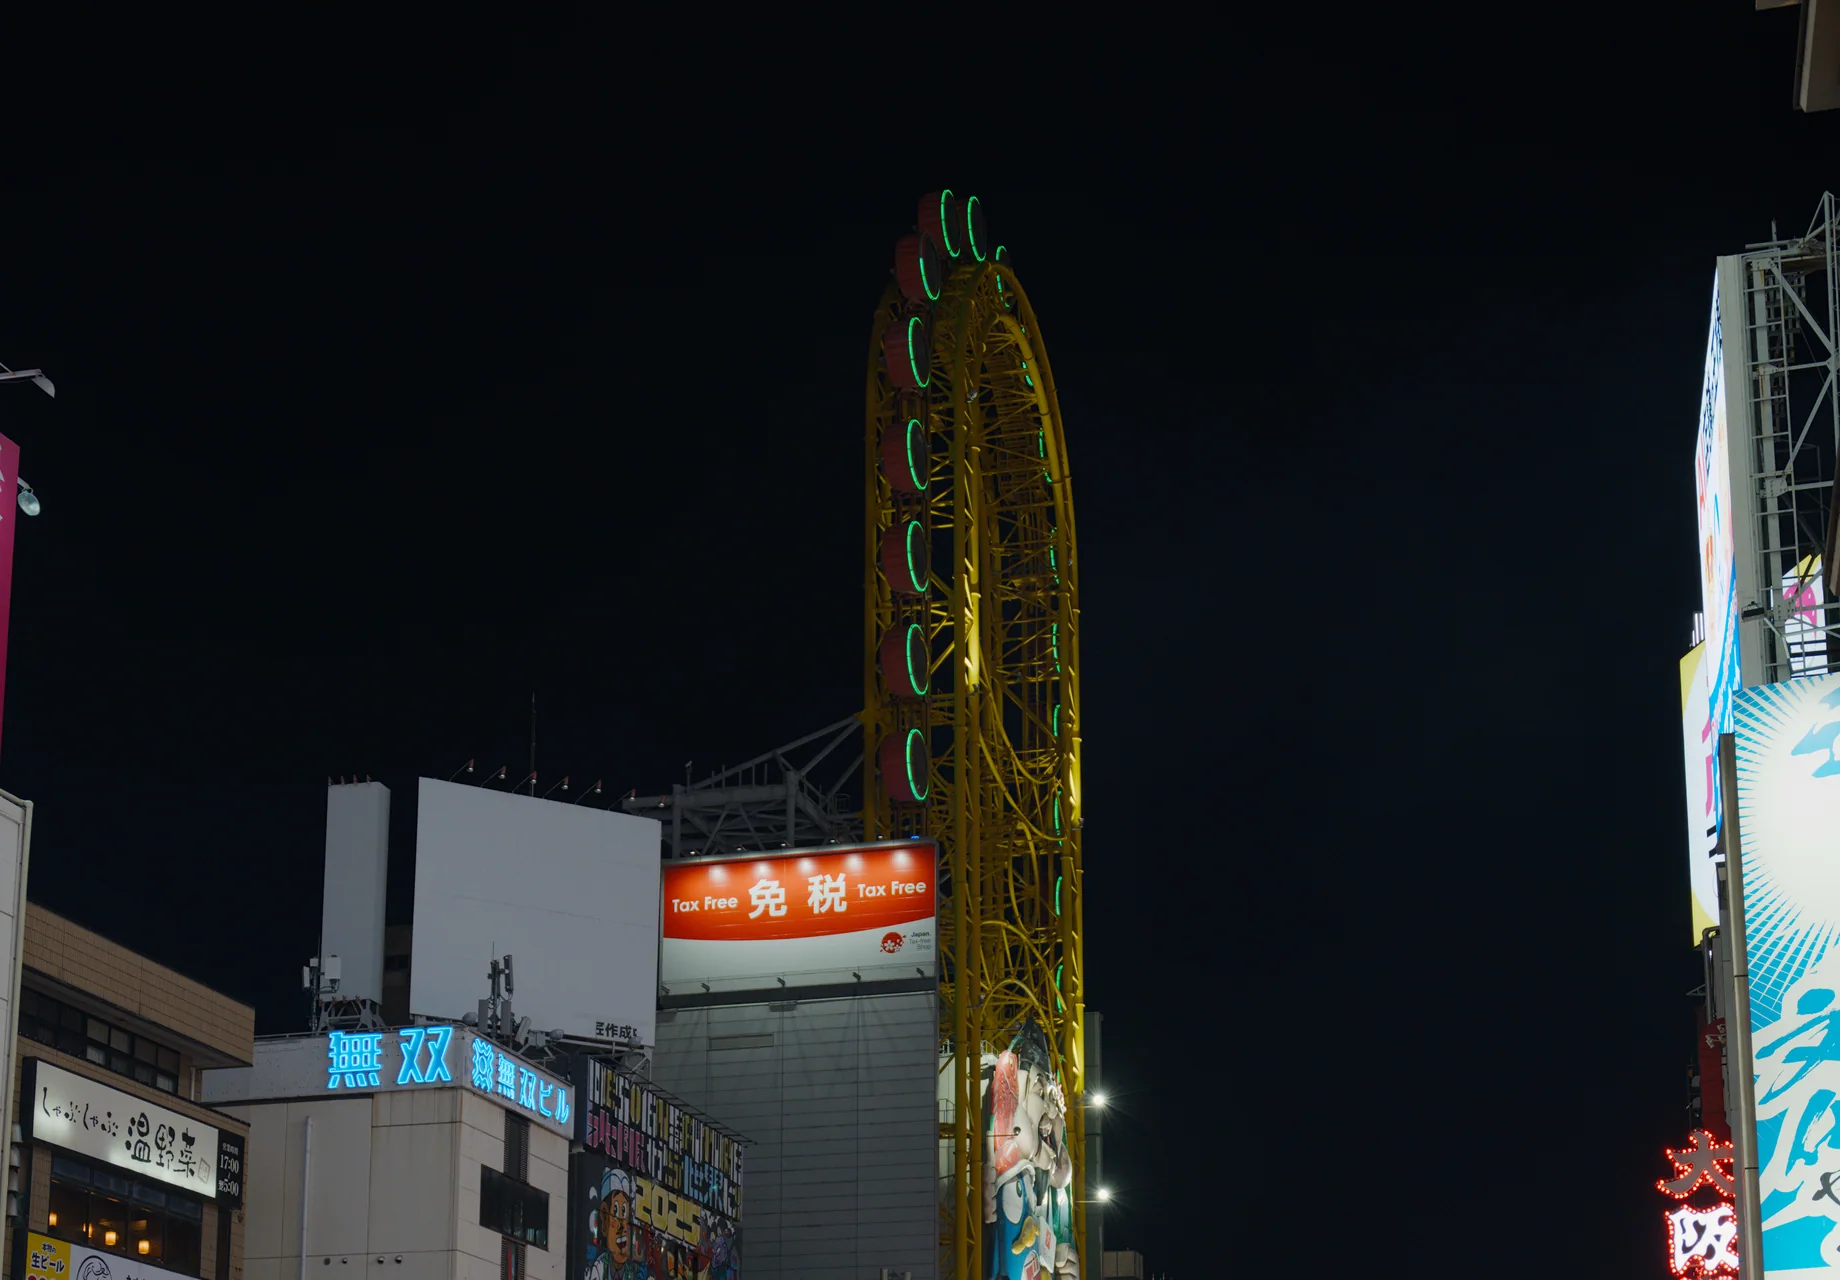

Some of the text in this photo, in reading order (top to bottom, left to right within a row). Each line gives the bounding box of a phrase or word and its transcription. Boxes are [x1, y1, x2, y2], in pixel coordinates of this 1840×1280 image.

[672, 873, 926, 919] Tax Free 免税 Tax Free
[327, 1026, 453, 1089] 無双
[498, 1053, 570, 1124] 無双ビル
[42, 1086, 197, 1178] しゃぶしゃぶ 温野菜
[220, 1154, 240, 1174] 17:00
[635, 1175, 701, 1248] 2025
[32, 1252, 65, 1272] 生ビール
